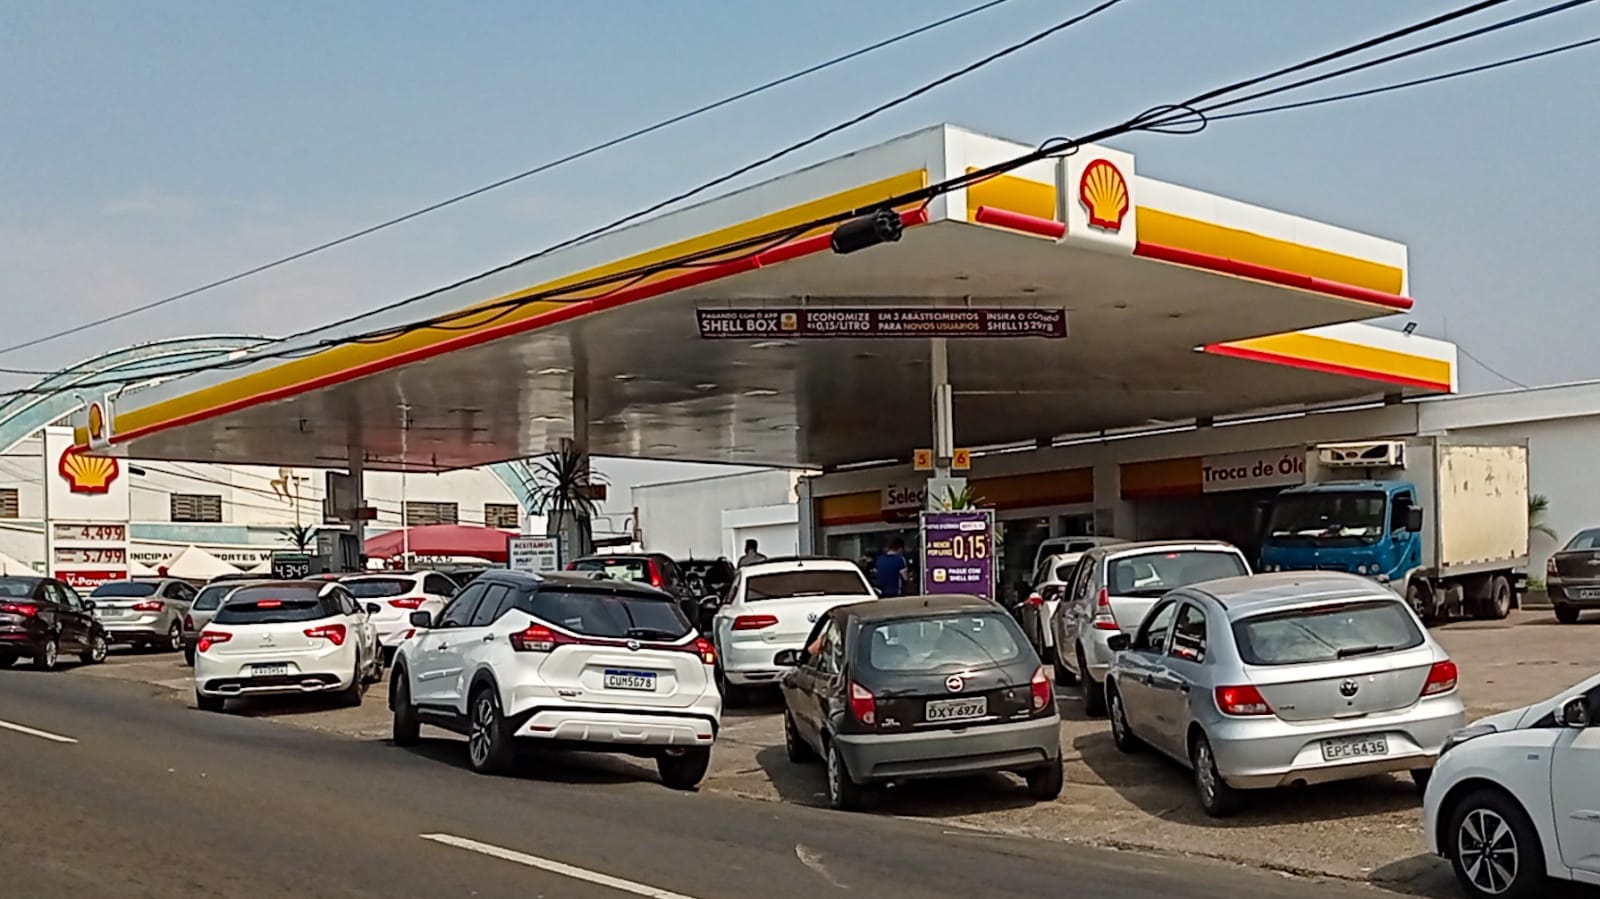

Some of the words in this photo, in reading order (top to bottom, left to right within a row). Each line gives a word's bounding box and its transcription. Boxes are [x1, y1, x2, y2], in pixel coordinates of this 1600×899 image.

[807, 312, 870, 321] ECONOMIZE
[893, 312, 899, 320] 3
[901, 312, 979, 320] ABASTECIMENTOS
[702, 320, 744, 331] SHELL
[747, 320, 777, 331] BOX
[878, 322, 901, 330] PARA
[903, 322, 935, 330] NOVOS
[936, 321, 979, 330] USUÁRIOS
[918, 454, 926, 465] 5
[957, 453, 966, 464] 6
[1203, 466, 1247, 482] Troca
[1252, 458, 1273, 476] de
[81, 527, 121, 539] 4.499
[953, 535, 986, 562] 0,15
[82, 550, 121, 562] 5.799
[609, 675, 652, 688] CUM5G78
[1326, 741, 1385, 757] EPC6435
